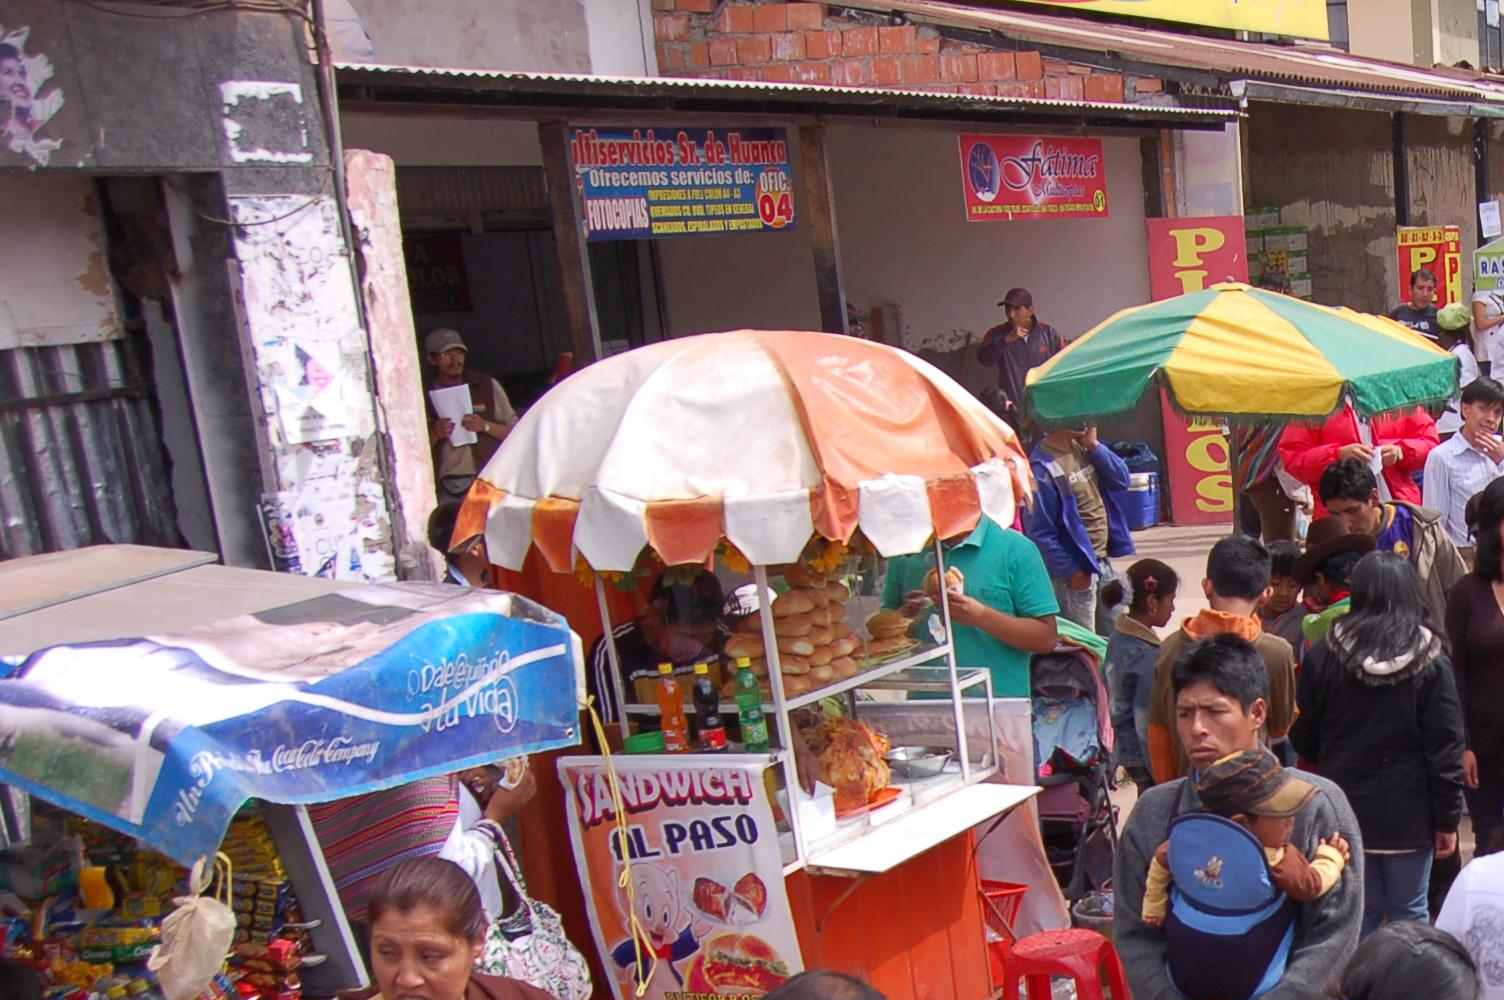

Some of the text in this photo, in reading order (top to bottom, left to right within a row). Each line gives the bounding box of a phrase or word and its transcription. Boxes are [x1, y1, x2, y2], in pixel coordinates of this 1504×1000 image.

[705, 131, 725, 165] de
[728, 132, 787, 164] Huanca
[590, 168, 754, 188] Ofrecemos servicios de:
[587, 198, 649, 231] FOTOCOPIAS
[758, 193, 794, 225] 04
[577, 768, 753, 830] SANDWICH
[612, 813, 760, 861] AL PASO
